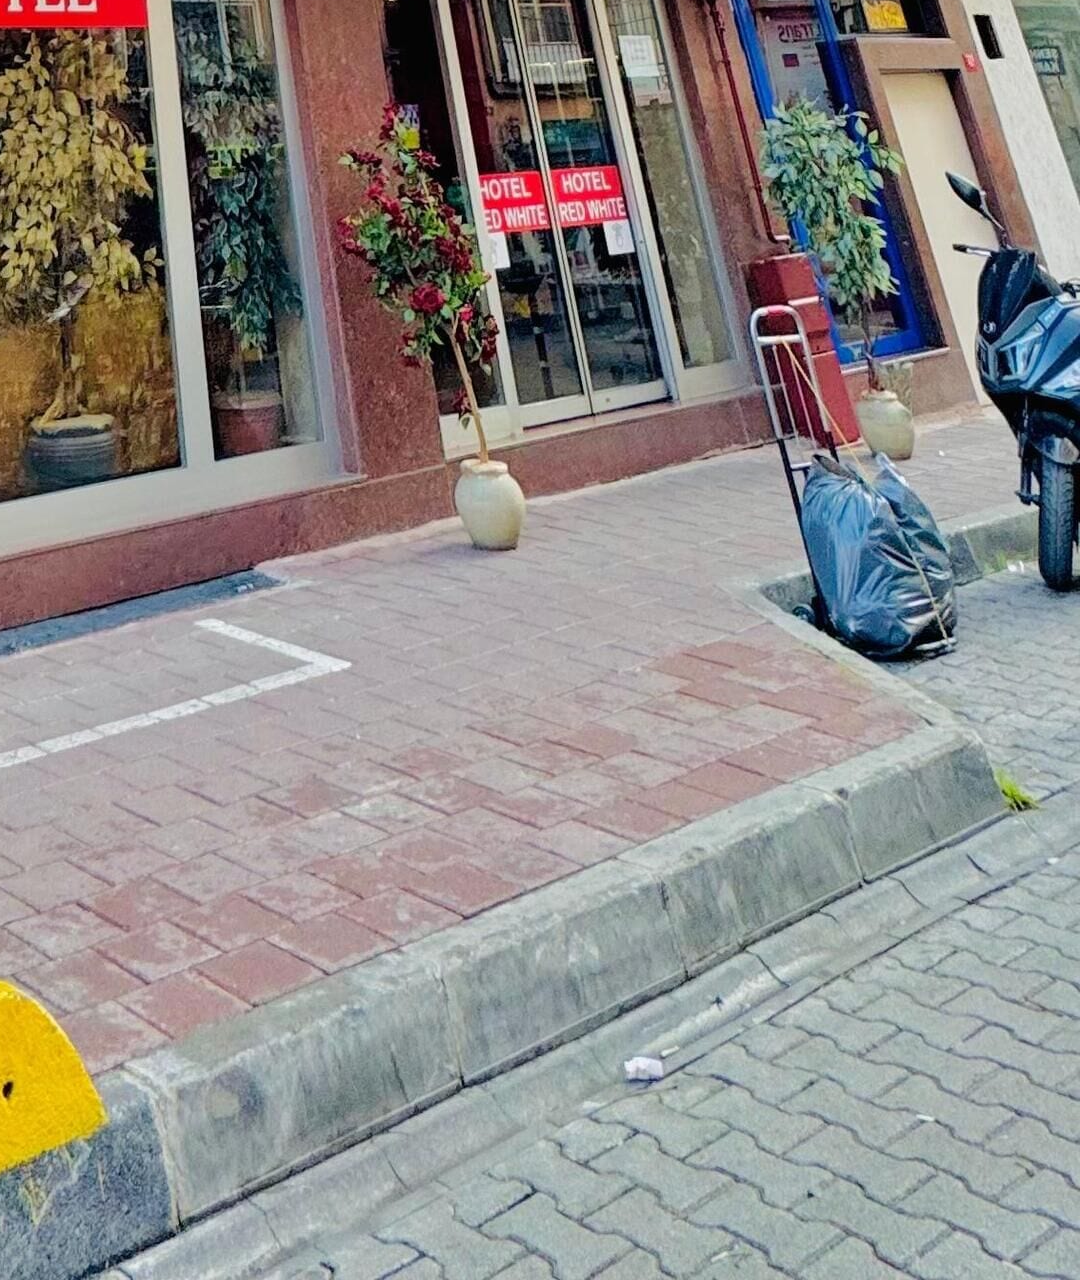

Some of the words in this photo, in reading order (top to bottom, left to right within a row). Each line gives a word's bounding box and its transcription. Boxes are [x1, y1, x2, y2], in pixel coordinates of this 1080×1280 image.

[561, 171, 612, 194] HOTEL
[483, 208, 502, 230] ED
[503, 204, 548, 228] WHITE
[559, 202, 586, 227] RED
[586, 197, 627, 220] WHITE
